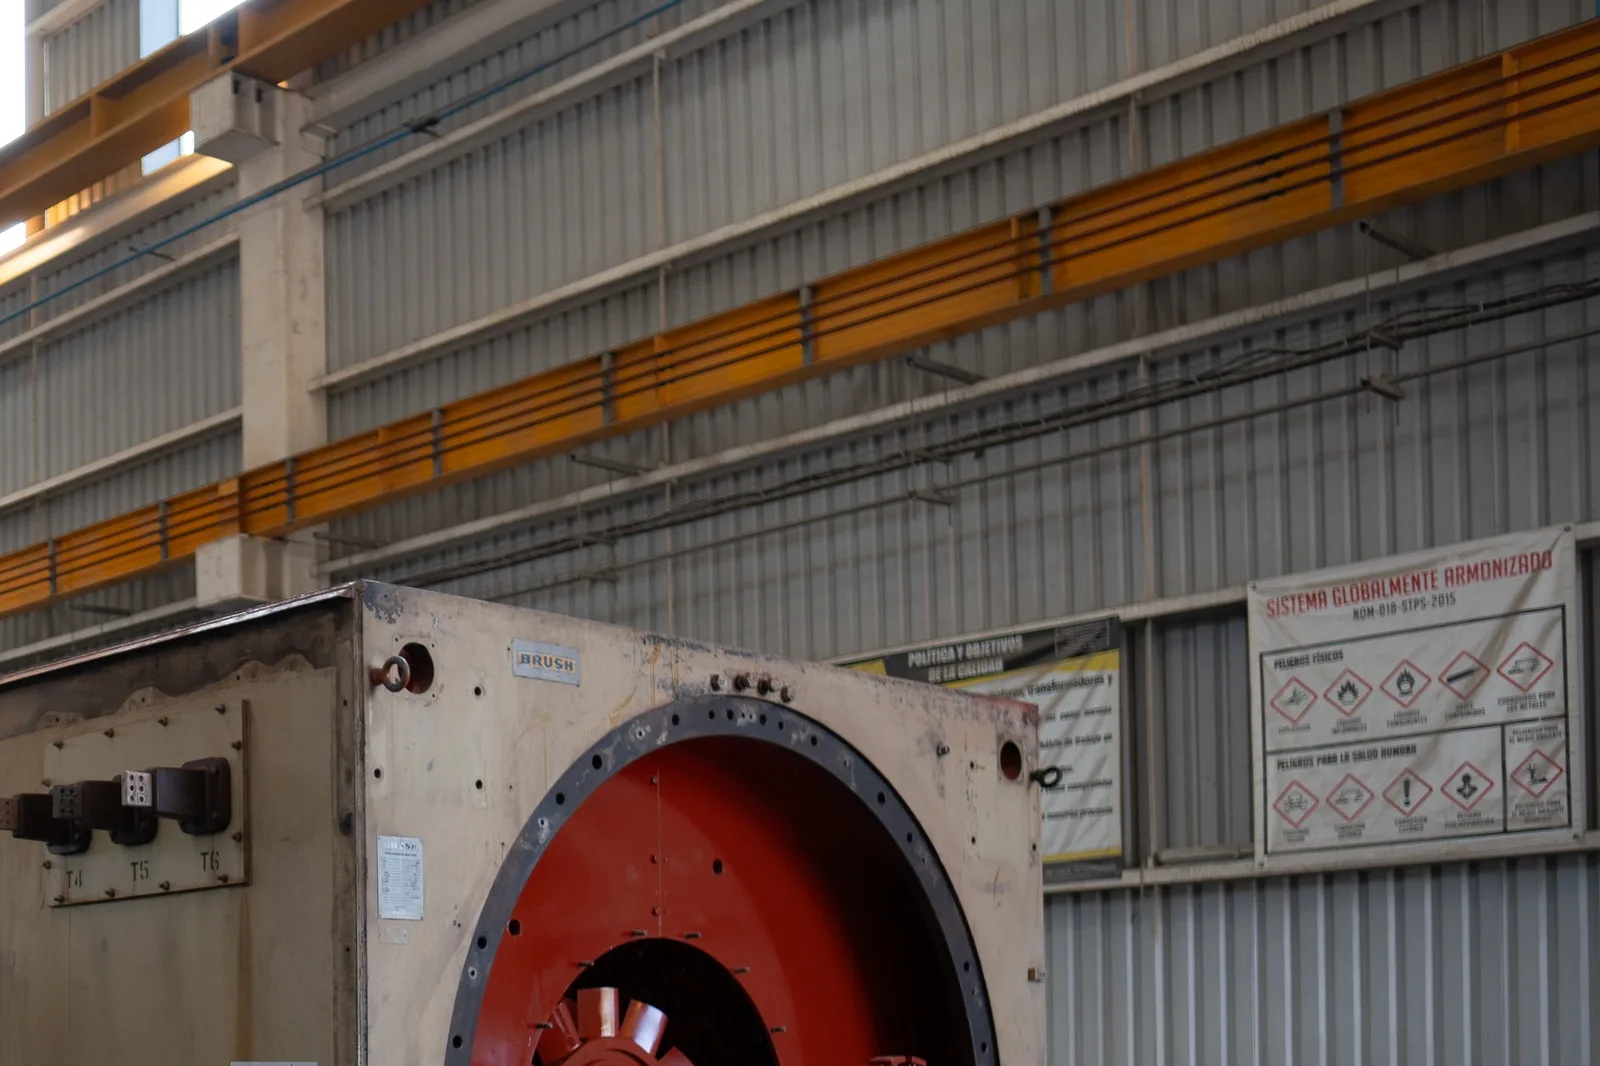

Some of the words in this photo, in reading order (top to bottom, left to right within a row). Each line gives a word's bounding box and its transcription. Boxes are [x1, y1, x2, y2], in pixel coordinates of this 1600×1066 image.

[1267, 588, 1328, 619] SISTEMA
[1332, 568, 1438, 608] GLOBALMENTE
[1444, 550, 1553, 588] ARMONIZADO
[957, 644, 963, 660] Y
[965, 635, 1023, 659] OBJETIVOS
[520, 653, 573, 672] BRUSH
[943, 664, 956, 679] LA
[957, 658, 1003, 679] CALIDAD
[1107, 674, 1113, 686] y
[1277, 755, 1314, 770] PELIGROS
[1316, 752, 1338, 766] PARA
[1340, 750, 1350, 764] LA
[1352, 748, 1379, 763] SALUD
[1380, 743, 1417, 759] HUMANA
[131, 860, 149, 882] T5
[201, 850, 220, 872] T6
[66, 869, 82, 889] T4
